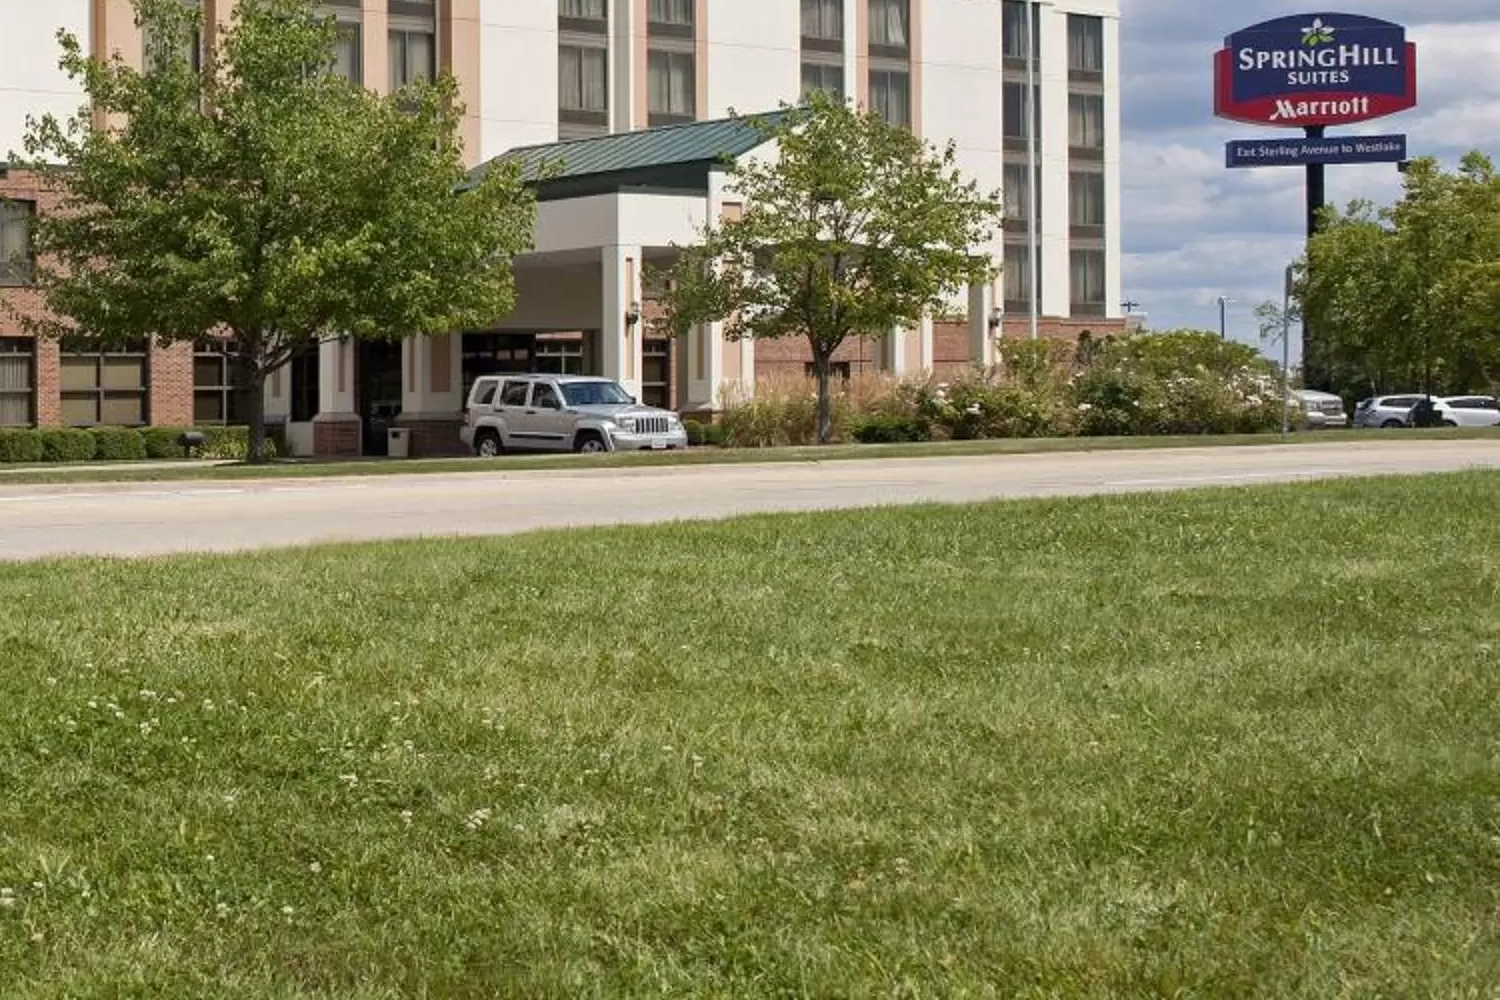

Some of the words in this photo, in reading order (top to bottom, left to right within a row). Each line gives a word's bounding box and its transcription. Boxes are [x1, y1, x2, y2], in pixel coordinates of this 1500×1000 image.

[1238, 44, 1399, 71] SPRINGHILL
[1287, 69, 1350, 86] SUITES
[1269, 96, 1369, 121] Marriott
[1259, 144, 1299, 158] Sterling
[1301, 144, 1339, 156] Avenue
[1341, 143, 1353, 153] to
